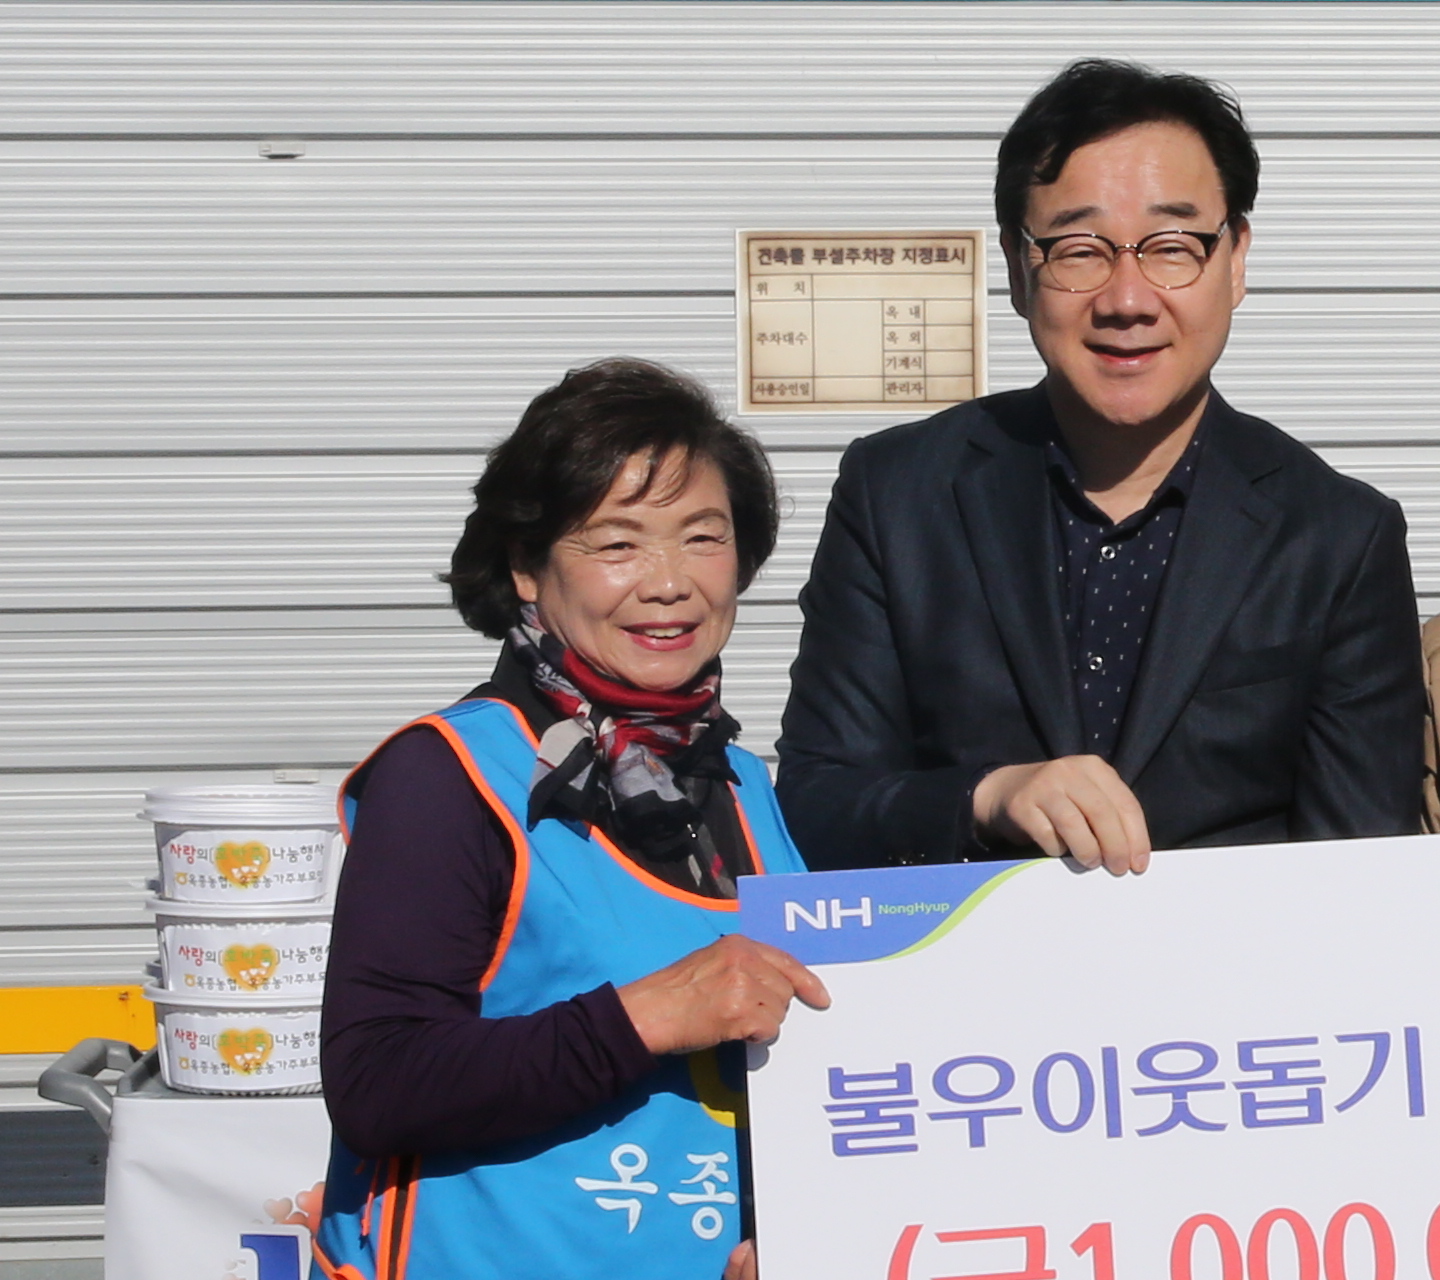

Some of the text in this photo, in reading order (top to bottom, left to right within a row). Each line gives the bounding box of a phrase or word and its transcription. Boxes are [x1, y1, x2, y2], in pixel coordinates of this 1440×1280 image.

[812, 247, 895, 265] 부설주차장
[901, 247, 965, 265] 지정표시
[755, 332, 808, 345] 주차대수
[885, 381, 924, 395] 관리자
[785, 897, 950, 932] NH NongHyup
[821, 1024, 1428, 1158] 불우이웃돕기
